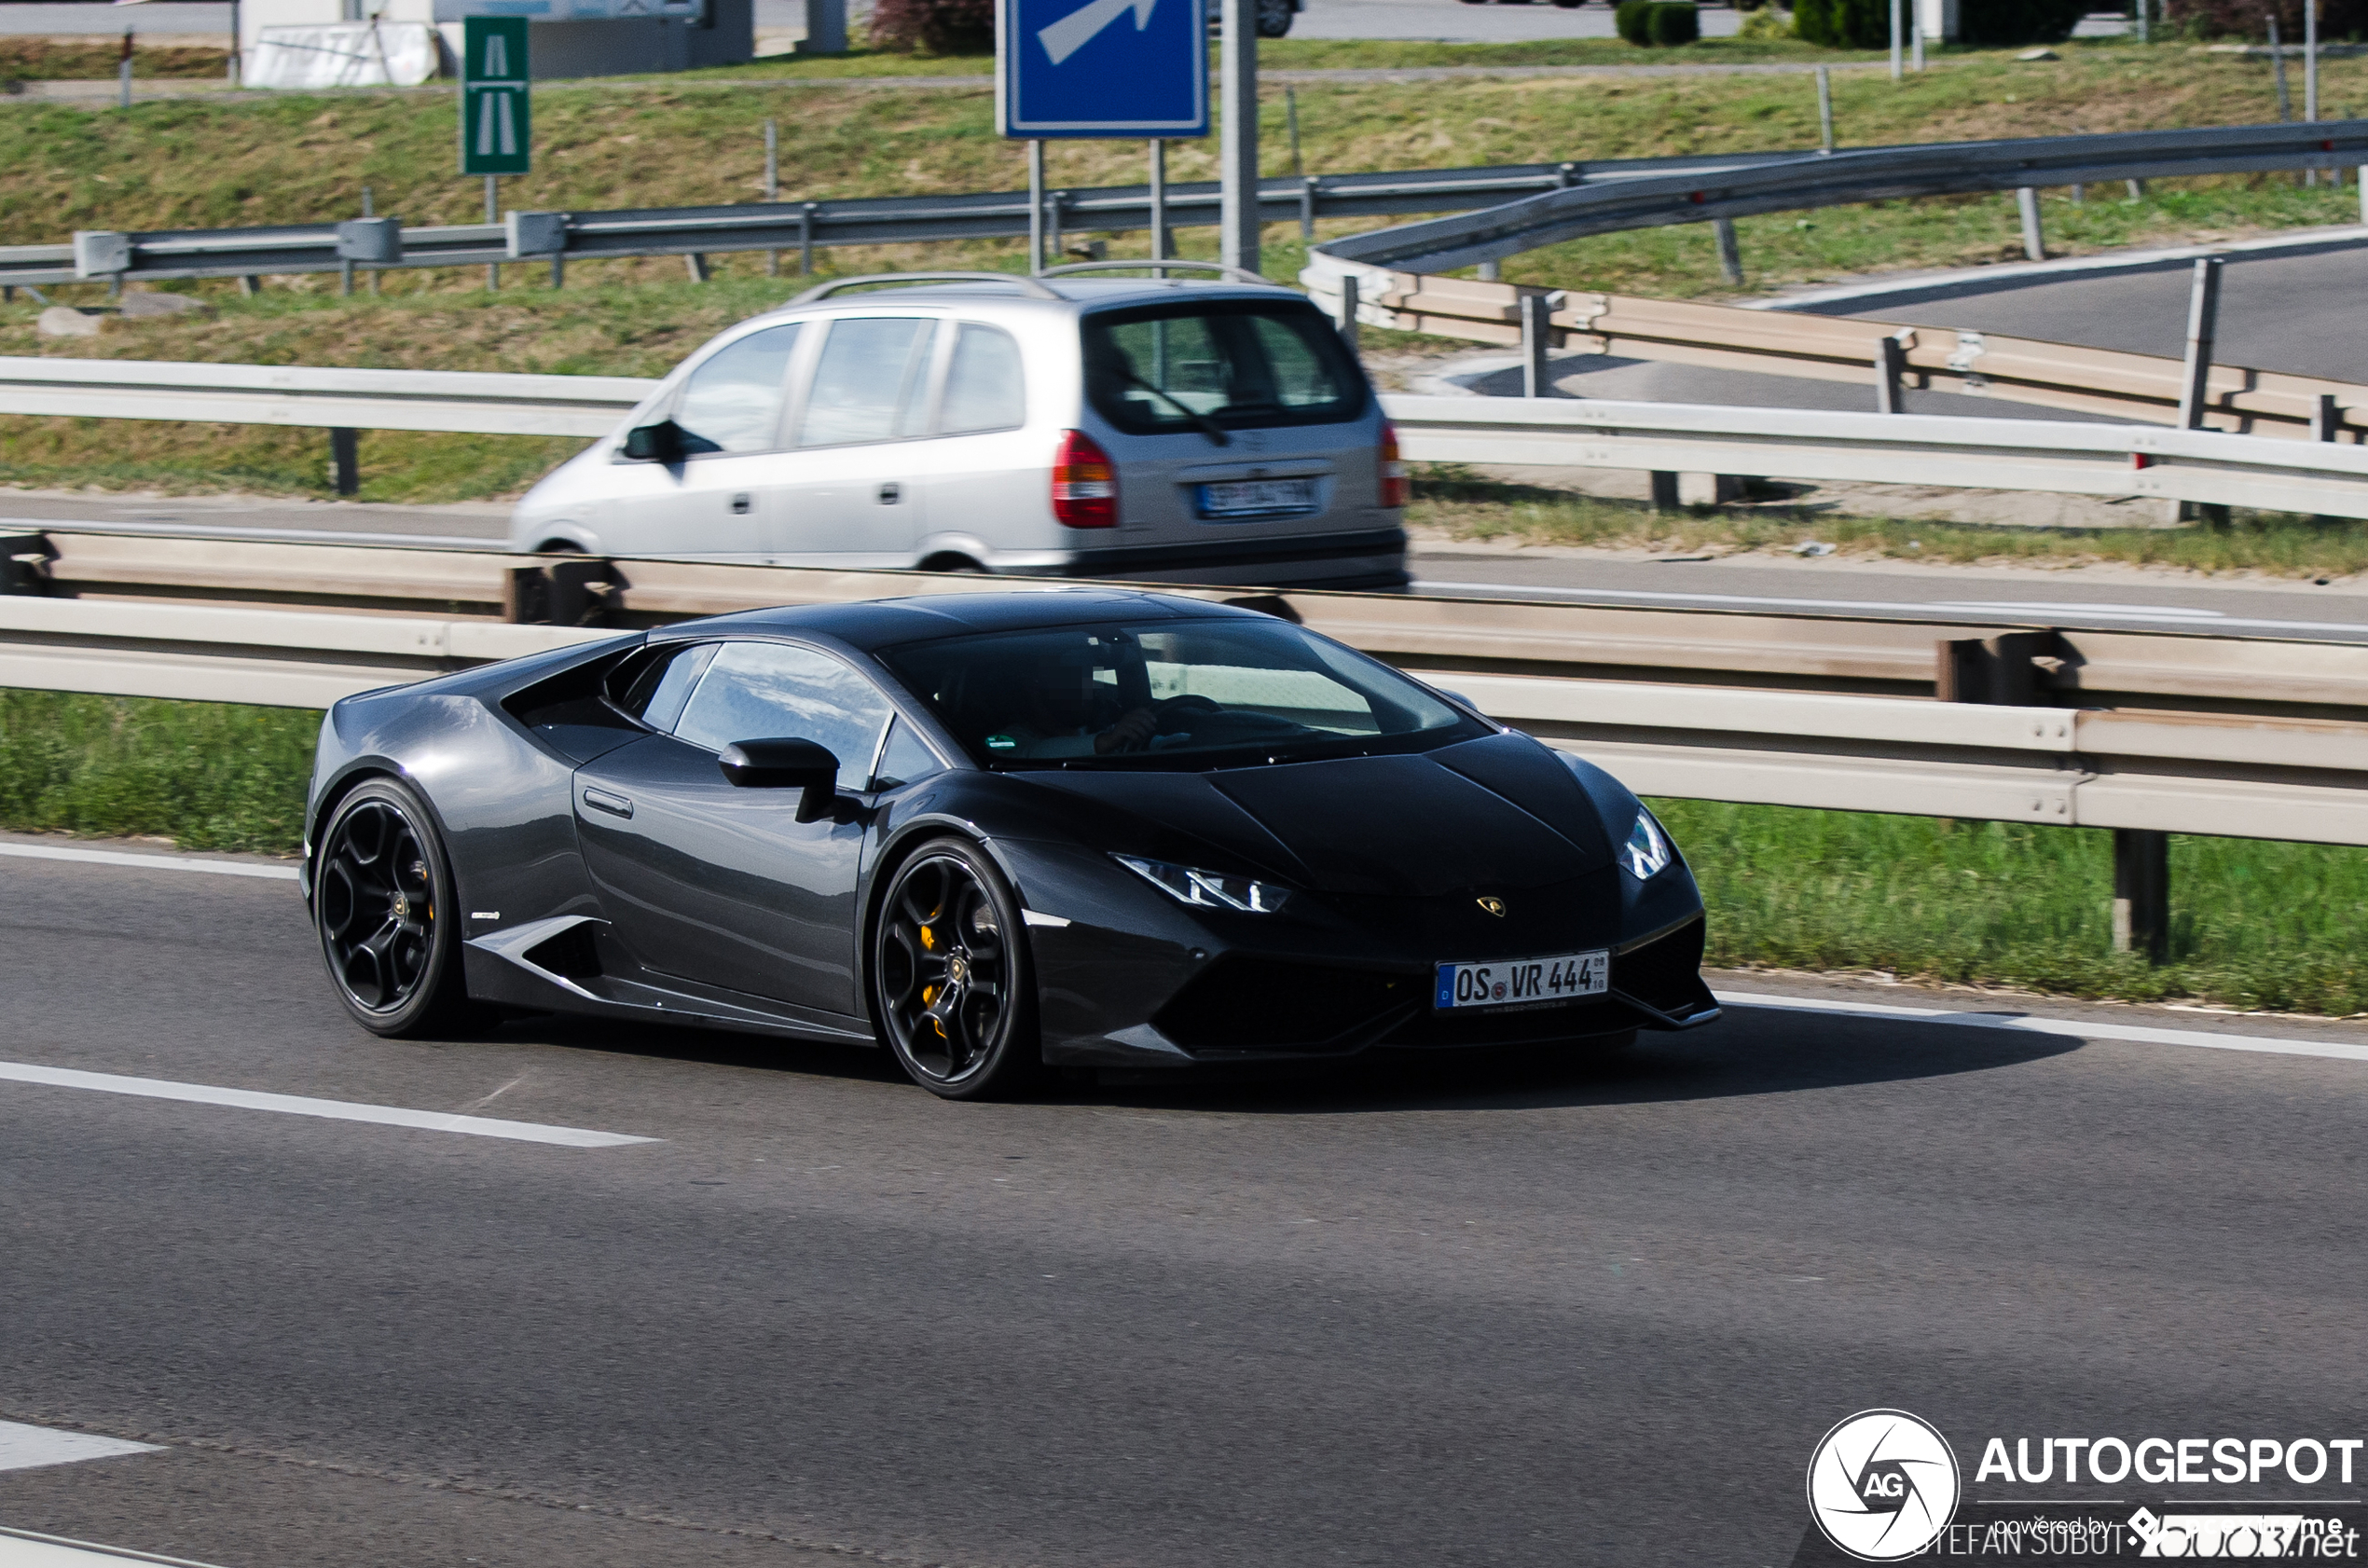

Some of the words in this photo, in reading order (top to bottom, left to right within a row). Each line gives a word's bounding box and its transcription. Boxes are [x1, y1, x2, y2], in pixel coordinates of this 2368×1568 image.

[1456, 968, 1492, 1002] OS
[1511, 964, 1542, 997] VR
[1548, 958, 1592, 995] 444
[1441, 990, 1450, 1000] D
